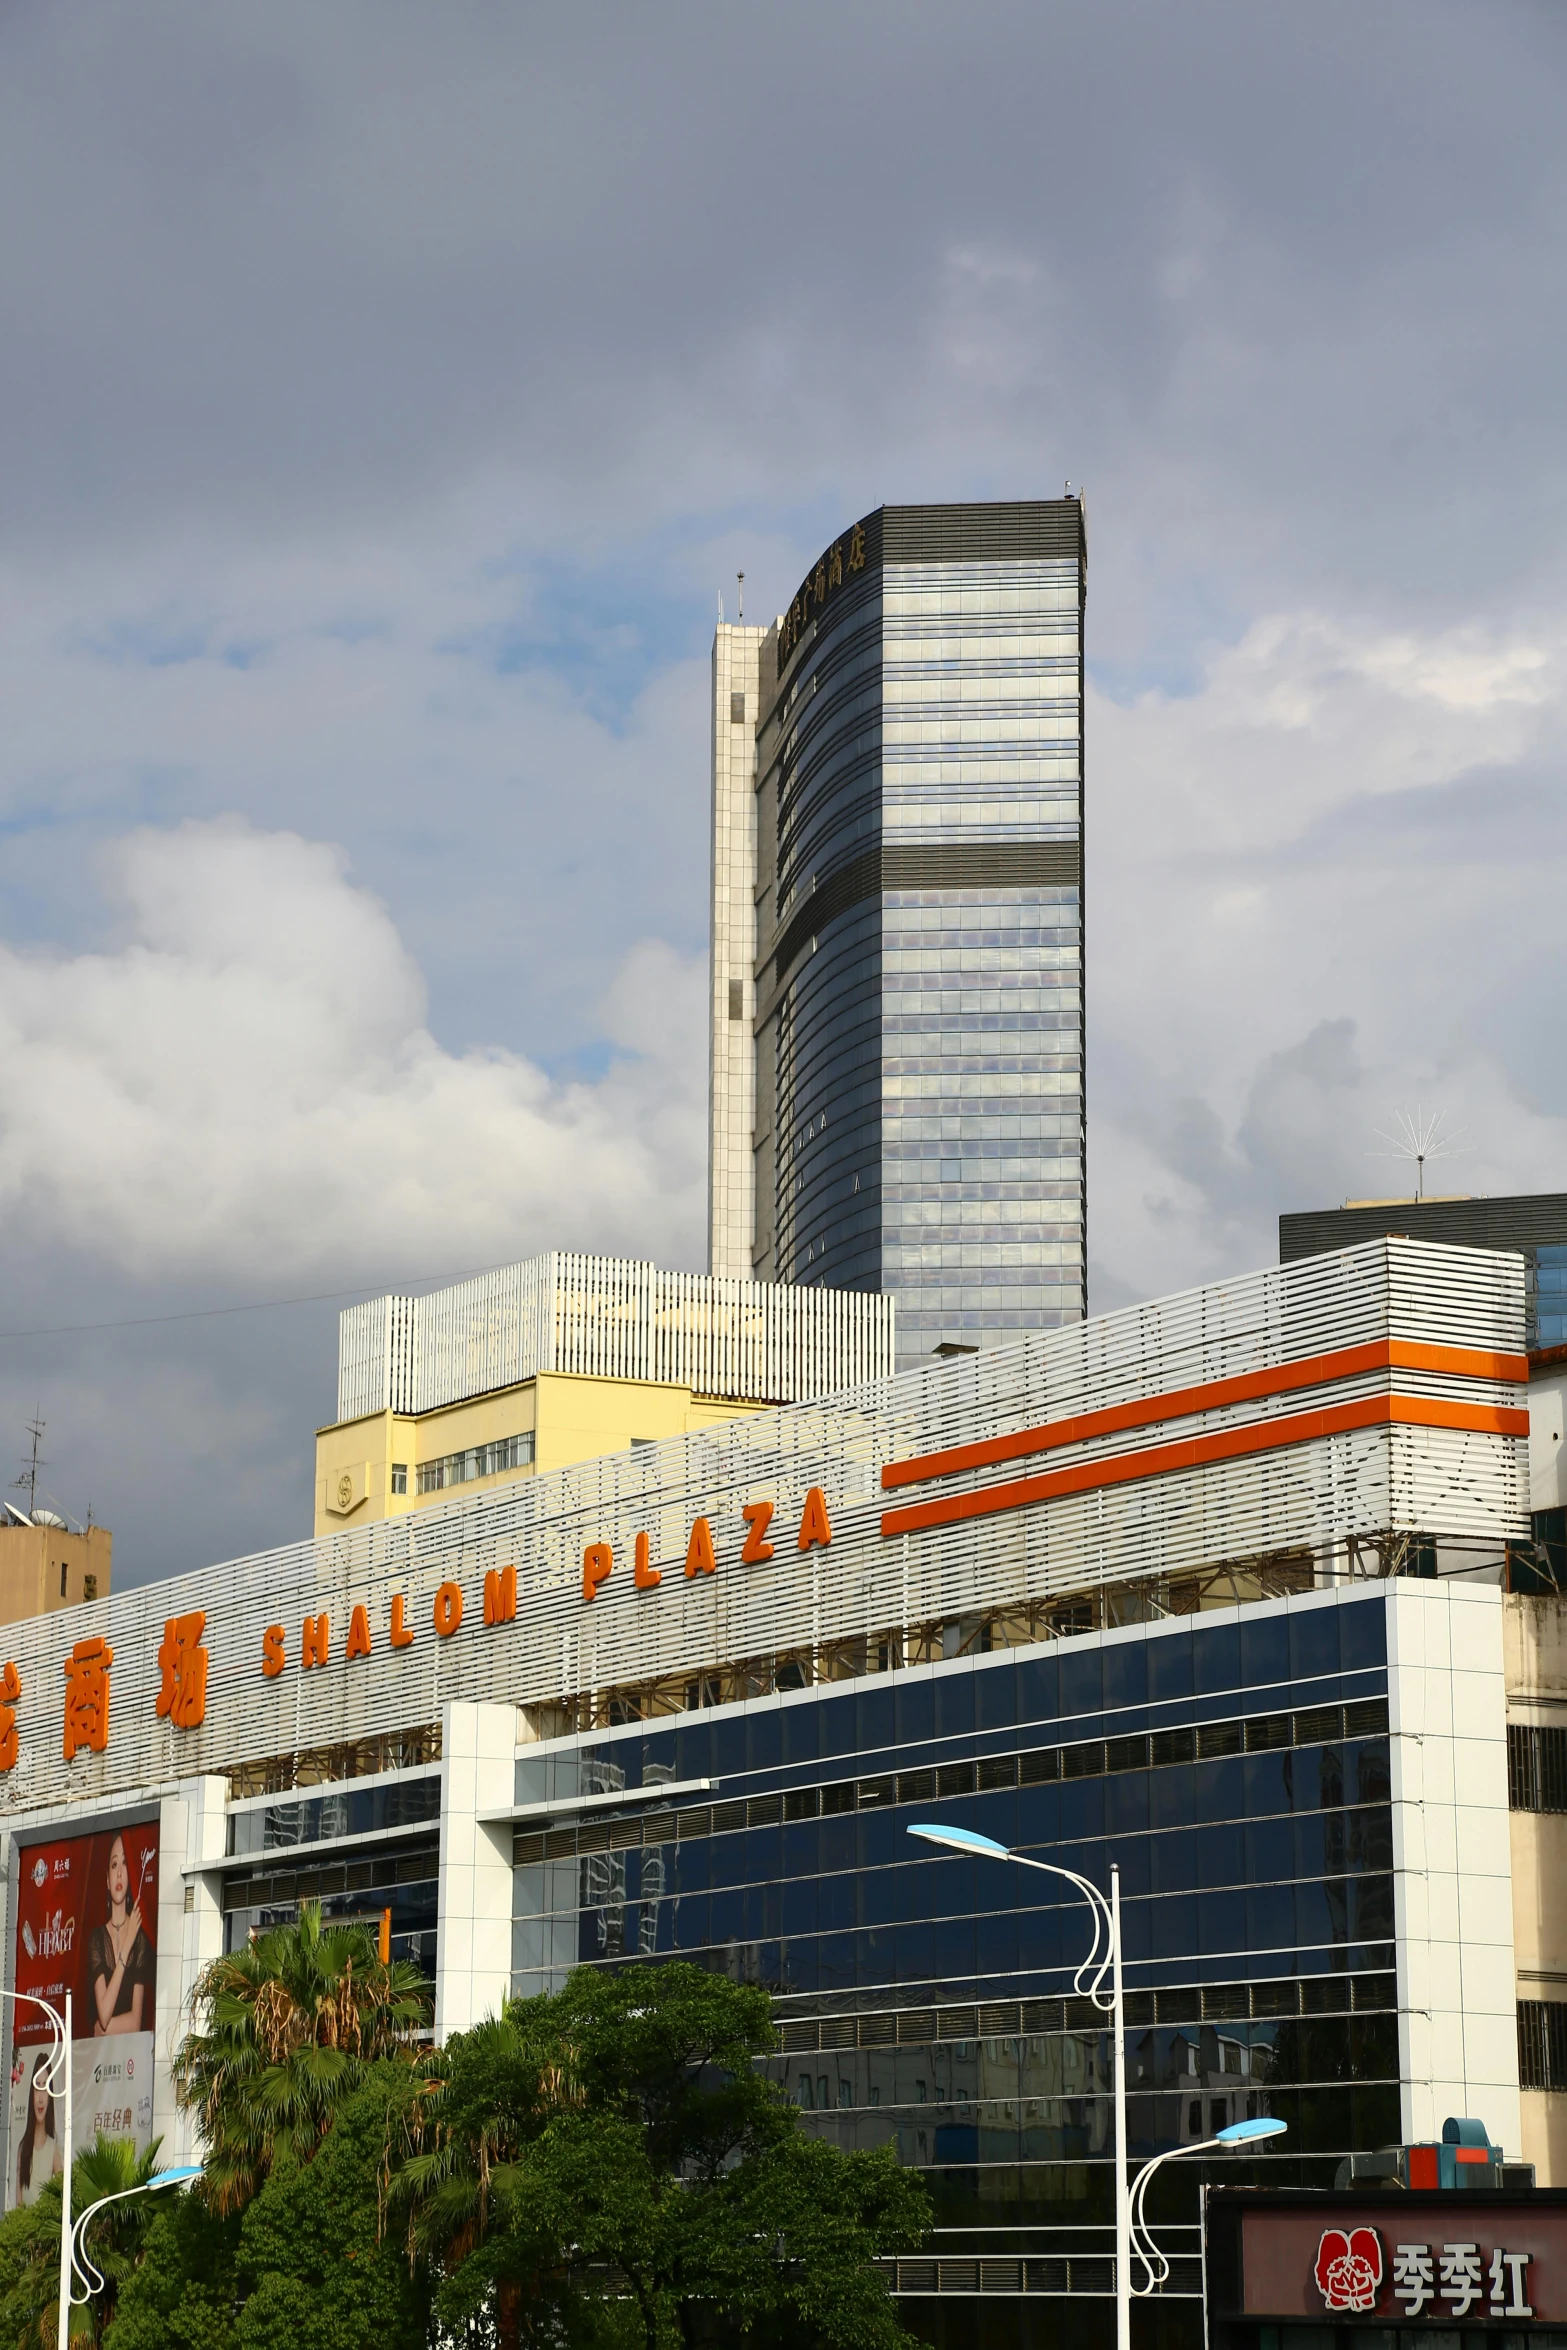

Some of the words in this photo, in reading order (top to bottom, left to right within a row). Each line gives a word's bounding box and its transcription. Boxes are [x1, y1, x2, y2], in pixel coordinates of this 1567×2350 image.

[262, 1565, 518, 1679] SHALOM
[582, 1487, 833, 1602] PLAZA
[53, 1858, 70, 1873] 周六福
[38, 1927, 74, 1956] HEART
[93, 2107, 132, 2132] 百年经典
[1394, 2244, 1533, 2316] 季季红
